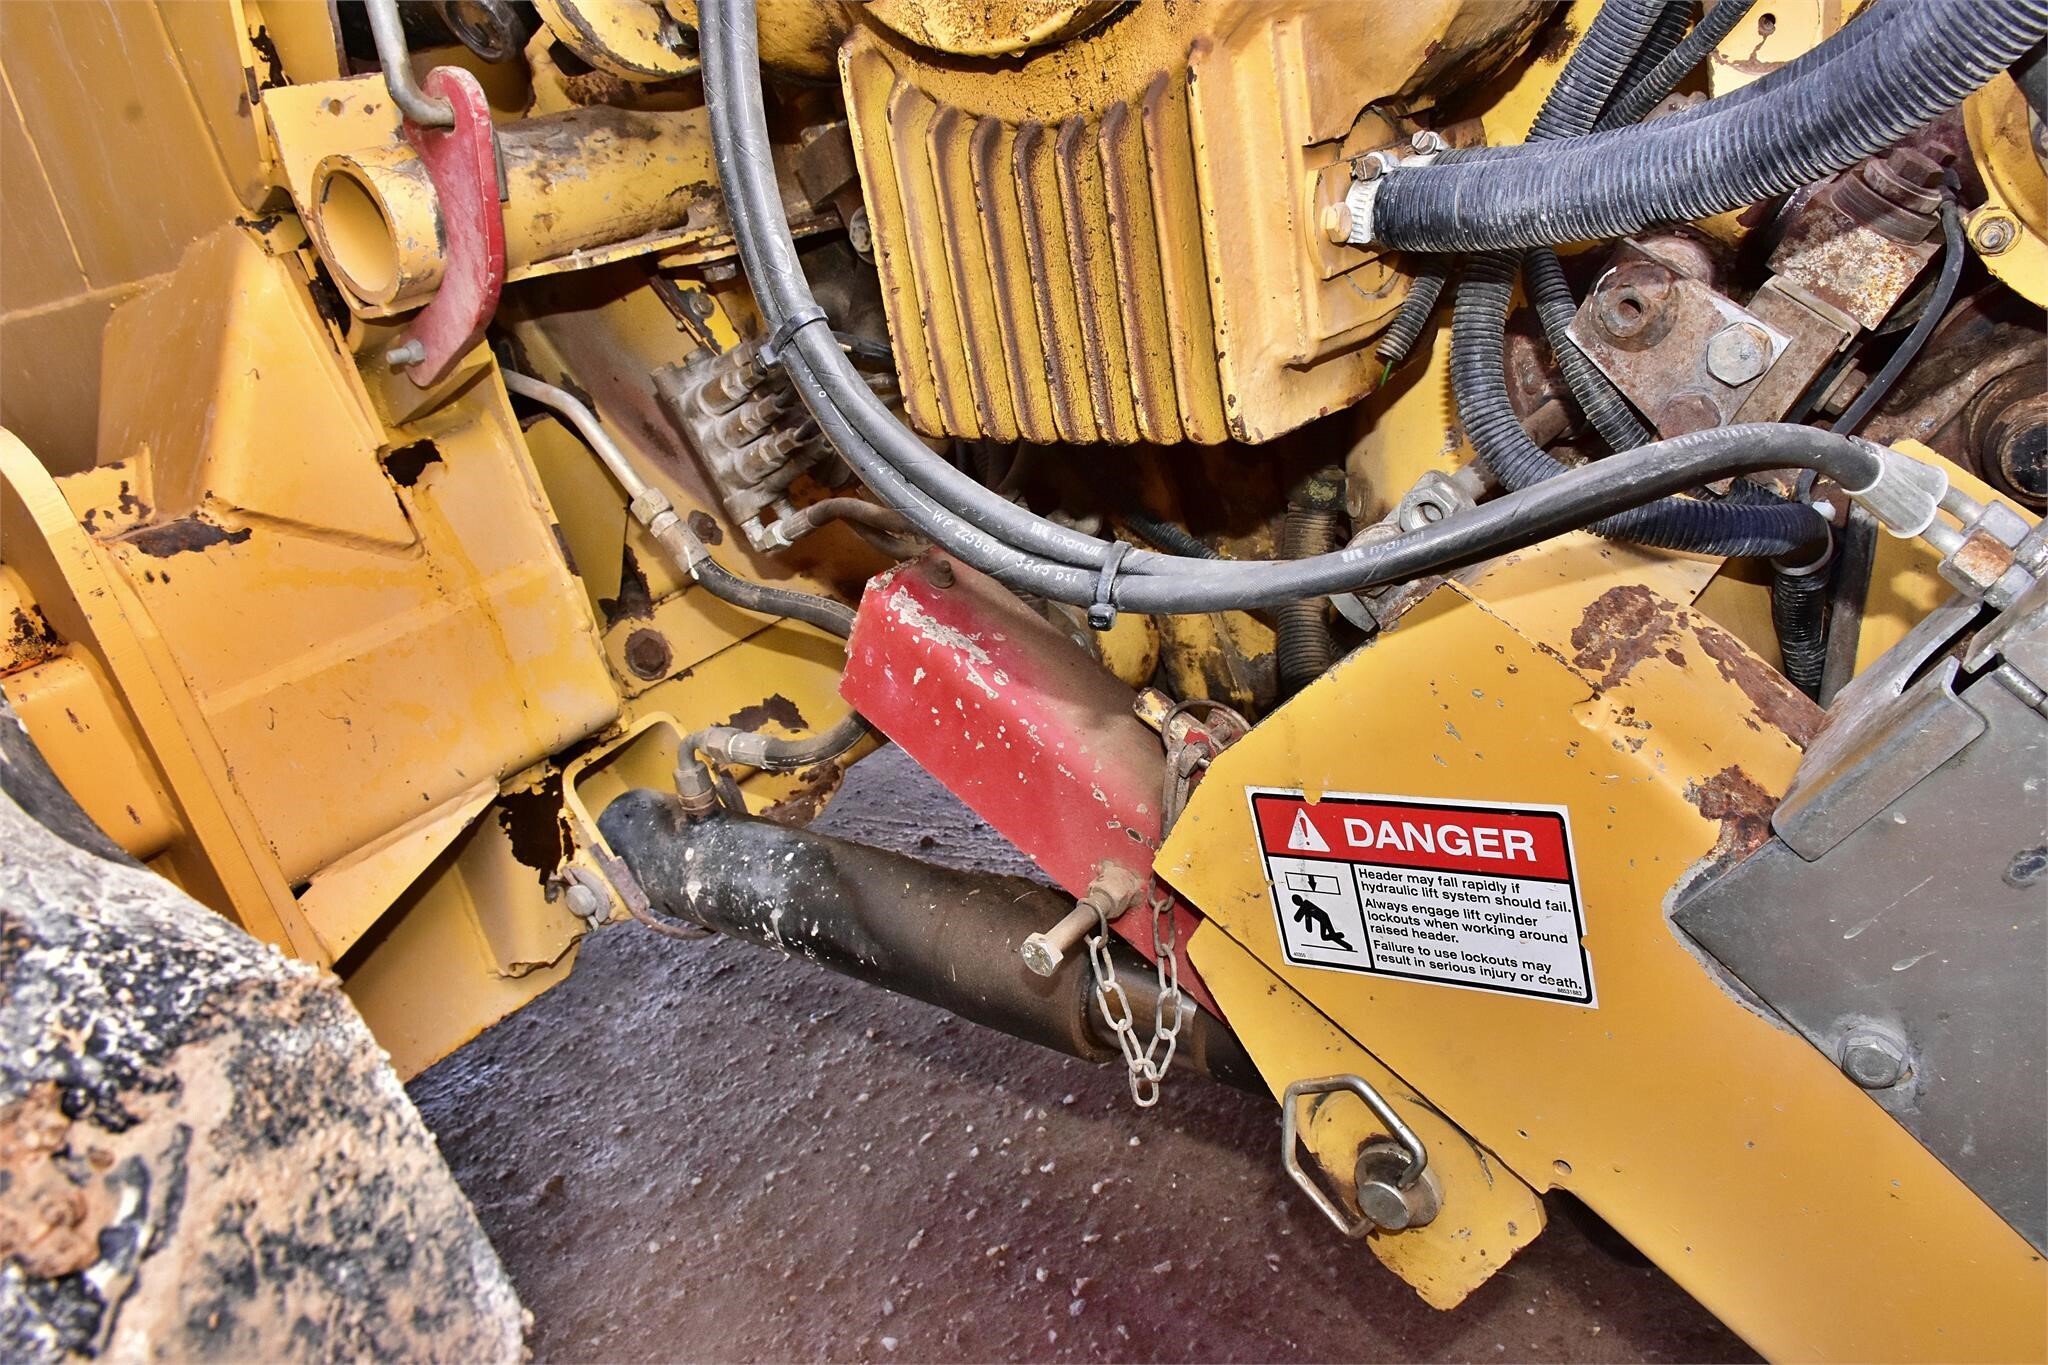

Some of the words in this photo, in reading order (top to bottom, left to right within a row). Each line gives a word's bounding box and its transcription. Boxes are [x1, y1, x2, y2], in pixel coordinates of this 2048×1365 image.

[932, 510, 954, 528] WP
[1055, 571, 1078, 583] psi
[1343, 817, 1536, 862] DANGER
[1359, 868, 1402, 882] Header
[1407, 875, 1434, 887] may
[1438, 876, 1458, 887] fall
[1462, 880, 1506, 894] rapidly
[1512, 883, 1520, 893] if
[1361, 881, 1418, 896] hydraulic
[1422, 887, 1439, 898] lift
[1442, 892, 1490, 904] system
[1495, 896, 1541, 909] should
[1546, 900, 1571, 912] fail.
[1366, 898, 1408, 913] Always
[1412, 906, 1459, 919] engage
[1463, 909, 1480, 920] lift
[1484, 913, 1537, 926] cylinder
[1368, 911, 1420, 926] lockouts
[1424, 918, 1458, 930] when
[1462, 924, 1514, 939] working
[1520, 931, 1568, 943] around
[1370, 925, 1408, 936] raised
[1412, 928, 1458, 943] header.
[1374, 940, 1414, 954] Failure
[1418, 946, 1430, 956] to
[1434, 950, 1457, 959] use
[1461, 951, 1517, 967] lockouts
[1522, 961, 1551, 974] may
[1376, 954, 1411, 965] result
[1414, 957, 1425, 967] in
[1429, 962, 1476, 974] serious
[1480, 966, 1516, 982] injury
[1521, 974, 1534, 982] or
[1539, 974, 1582, 989] death.
